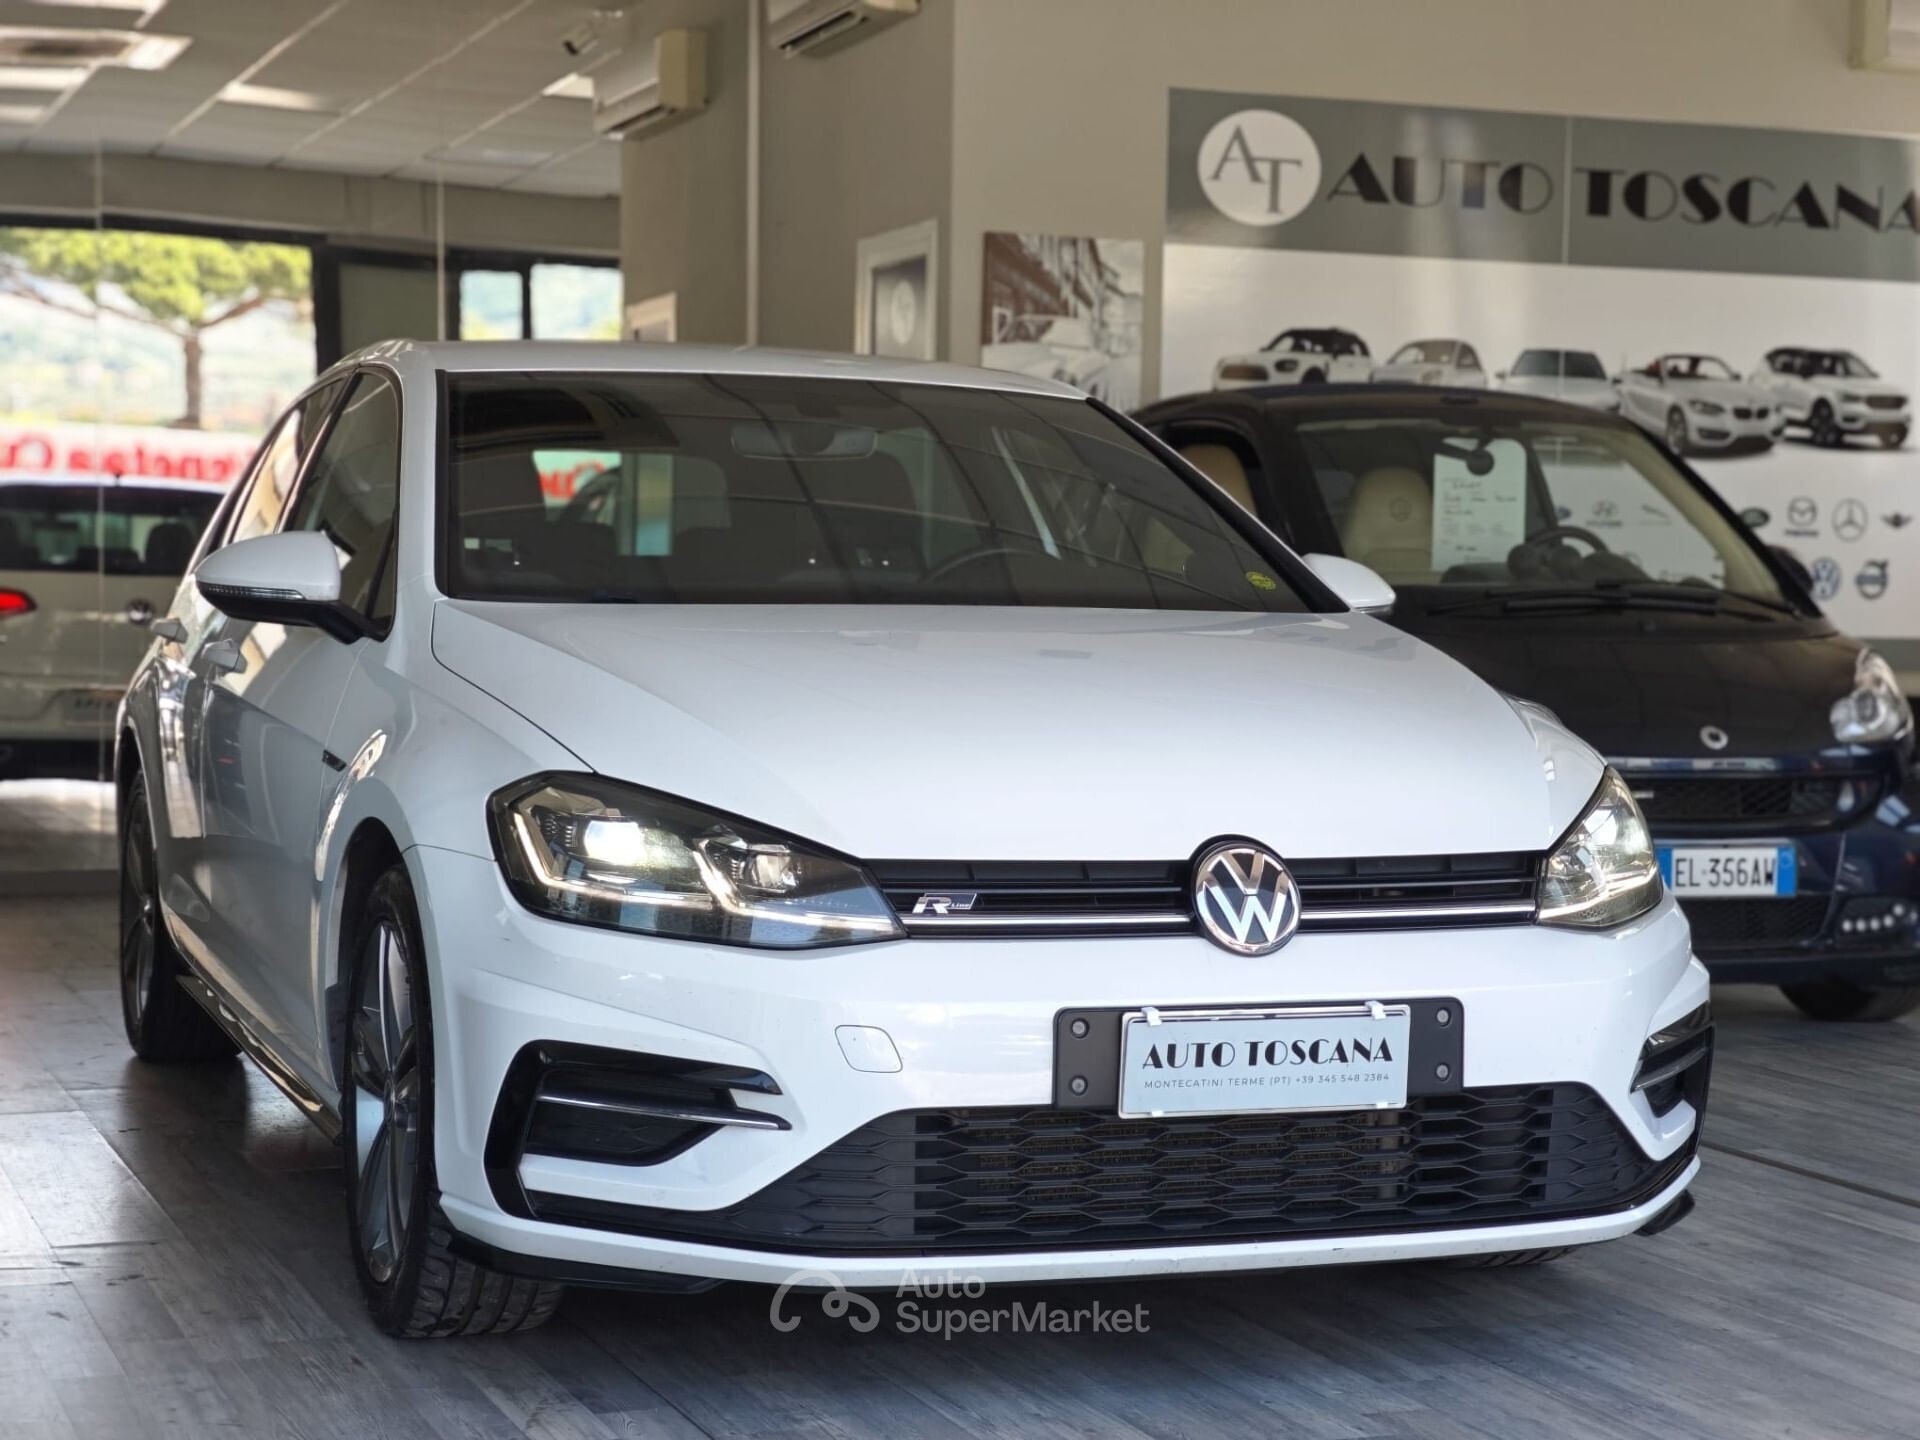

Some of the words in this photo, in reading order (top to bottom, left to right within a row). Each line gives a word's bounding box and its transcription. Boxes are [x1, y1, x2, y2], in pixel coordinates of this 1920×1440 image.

[1327, 152, 1553, 215] AUTO
[1573, 166, 1920, 235] TOSCANA
[1142, 1041, 1236, 1069] AUTO
[1244, 1036, 1393, 1066] TOSCANA
[1144, 1078, 1223, 1089] MONTECATINI
[1228, 1076, 1265, 1087] TERME
[1269, 1075, 1291, 1087] (PT)
